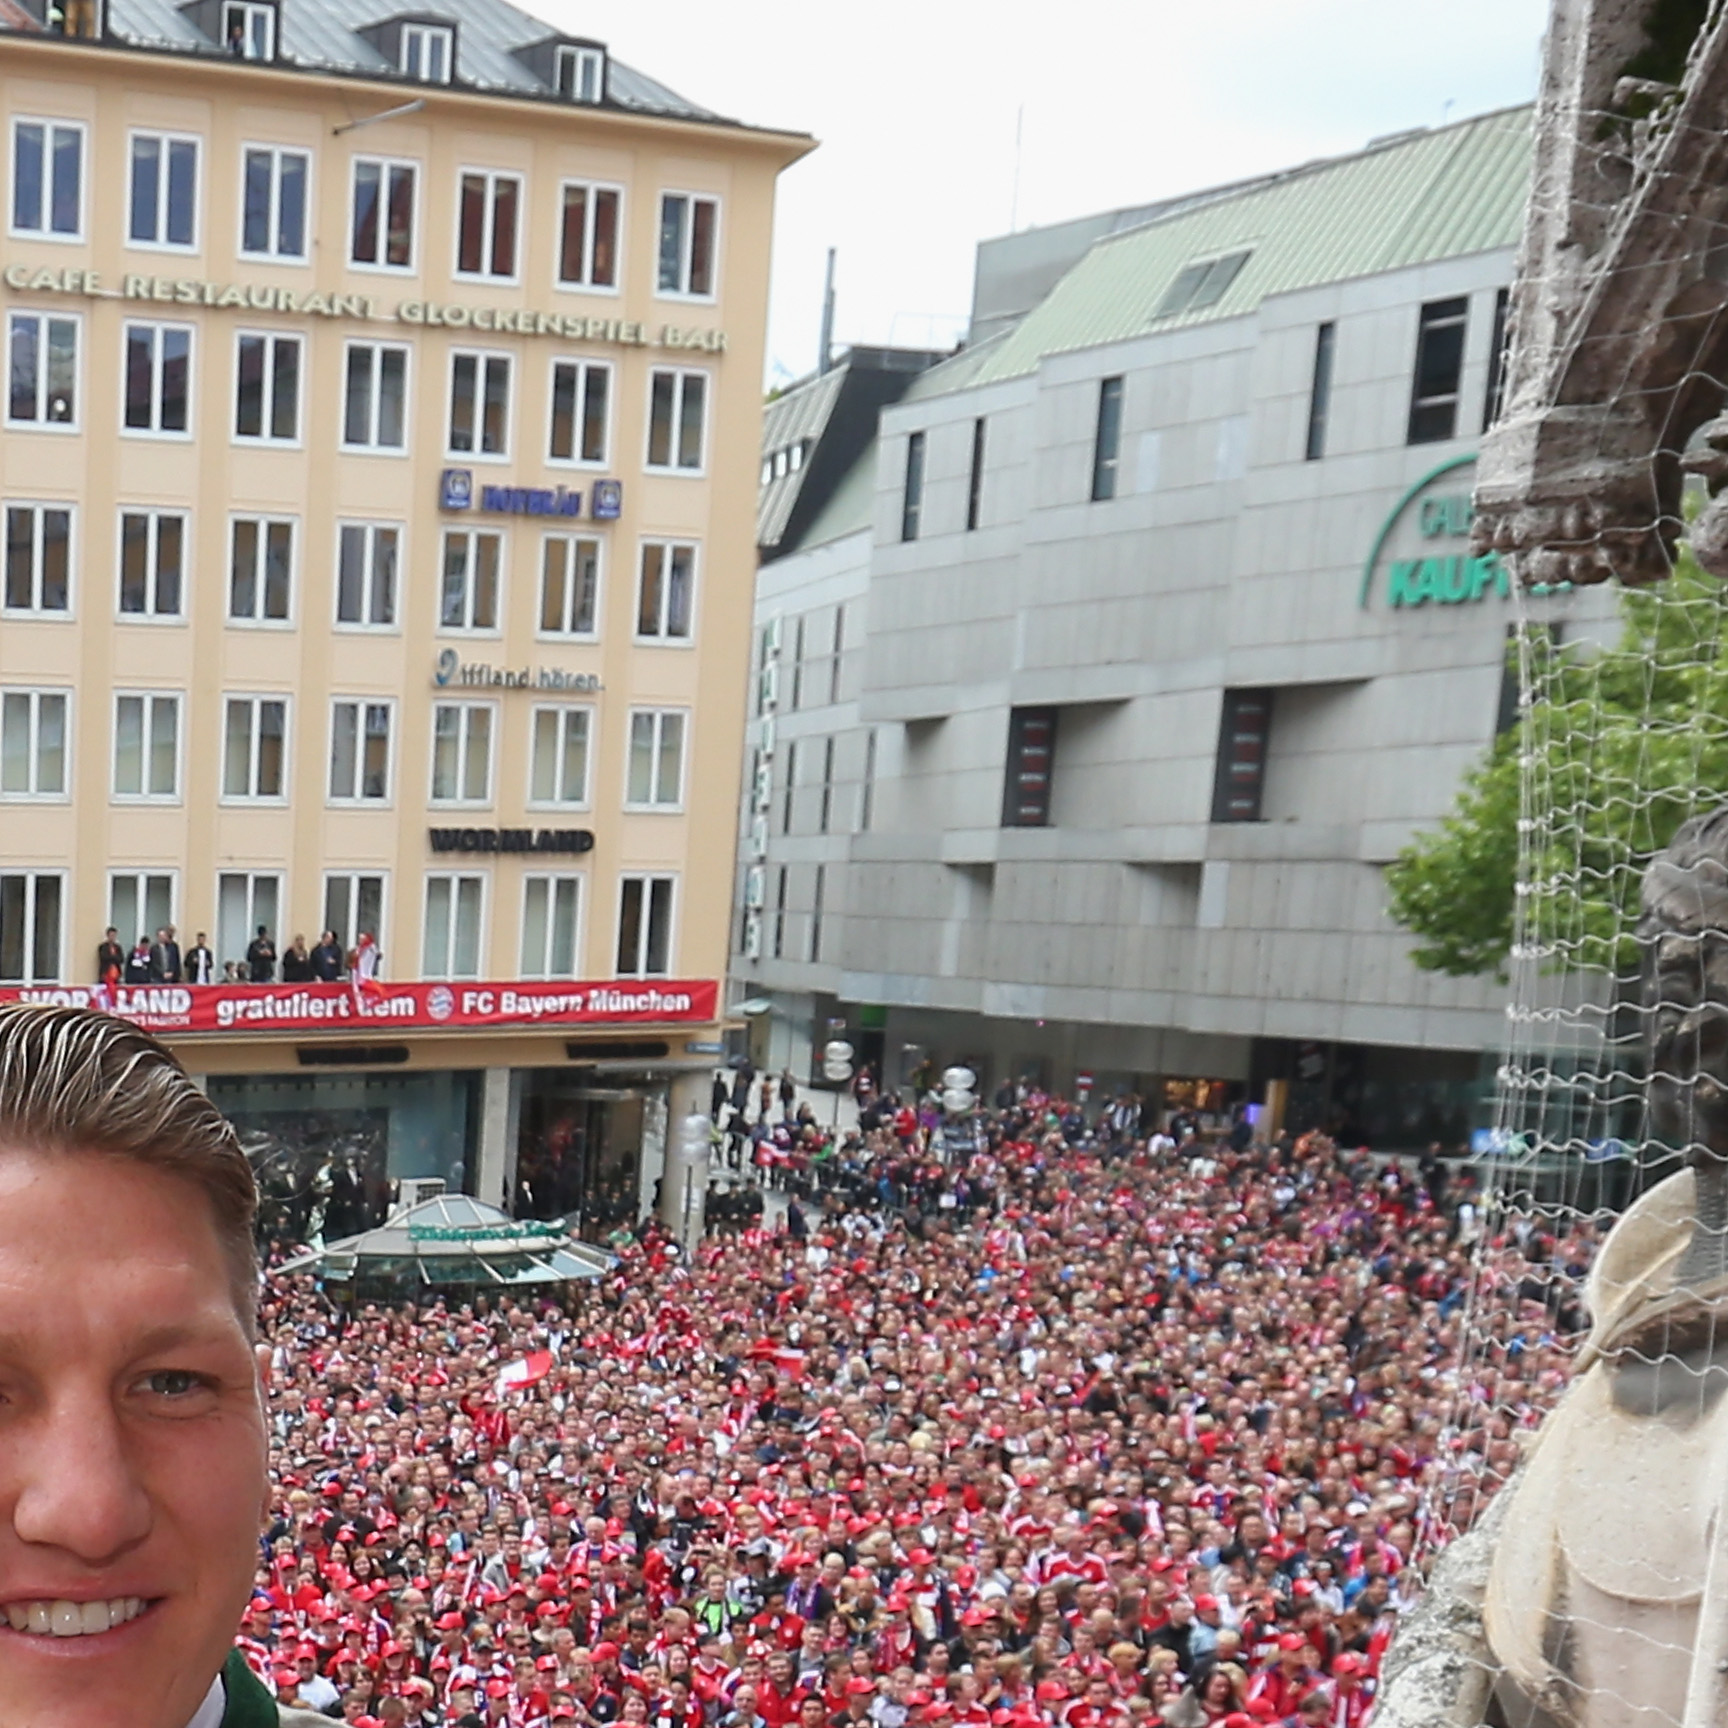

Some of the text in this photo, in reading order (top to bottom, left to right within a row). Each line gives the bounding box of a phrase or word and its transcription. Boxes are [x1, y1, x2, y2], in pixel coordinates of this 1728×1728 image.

[123, 273, 377, 321] RESTAURANT
[397, 300, 652, 347] GLOCKENSPIEL
[661, 323, 730, 352] BAR
[429, 827, 595, 853] WORMLAND
[19, 988, 192, 1015] WORLAND
[216, 992, 350, 1026] gratuliert
[461, 991, 495, 1015] FC
[501, 991, 583, 1018] Bayern
[588, 988, 691, 1013] München
